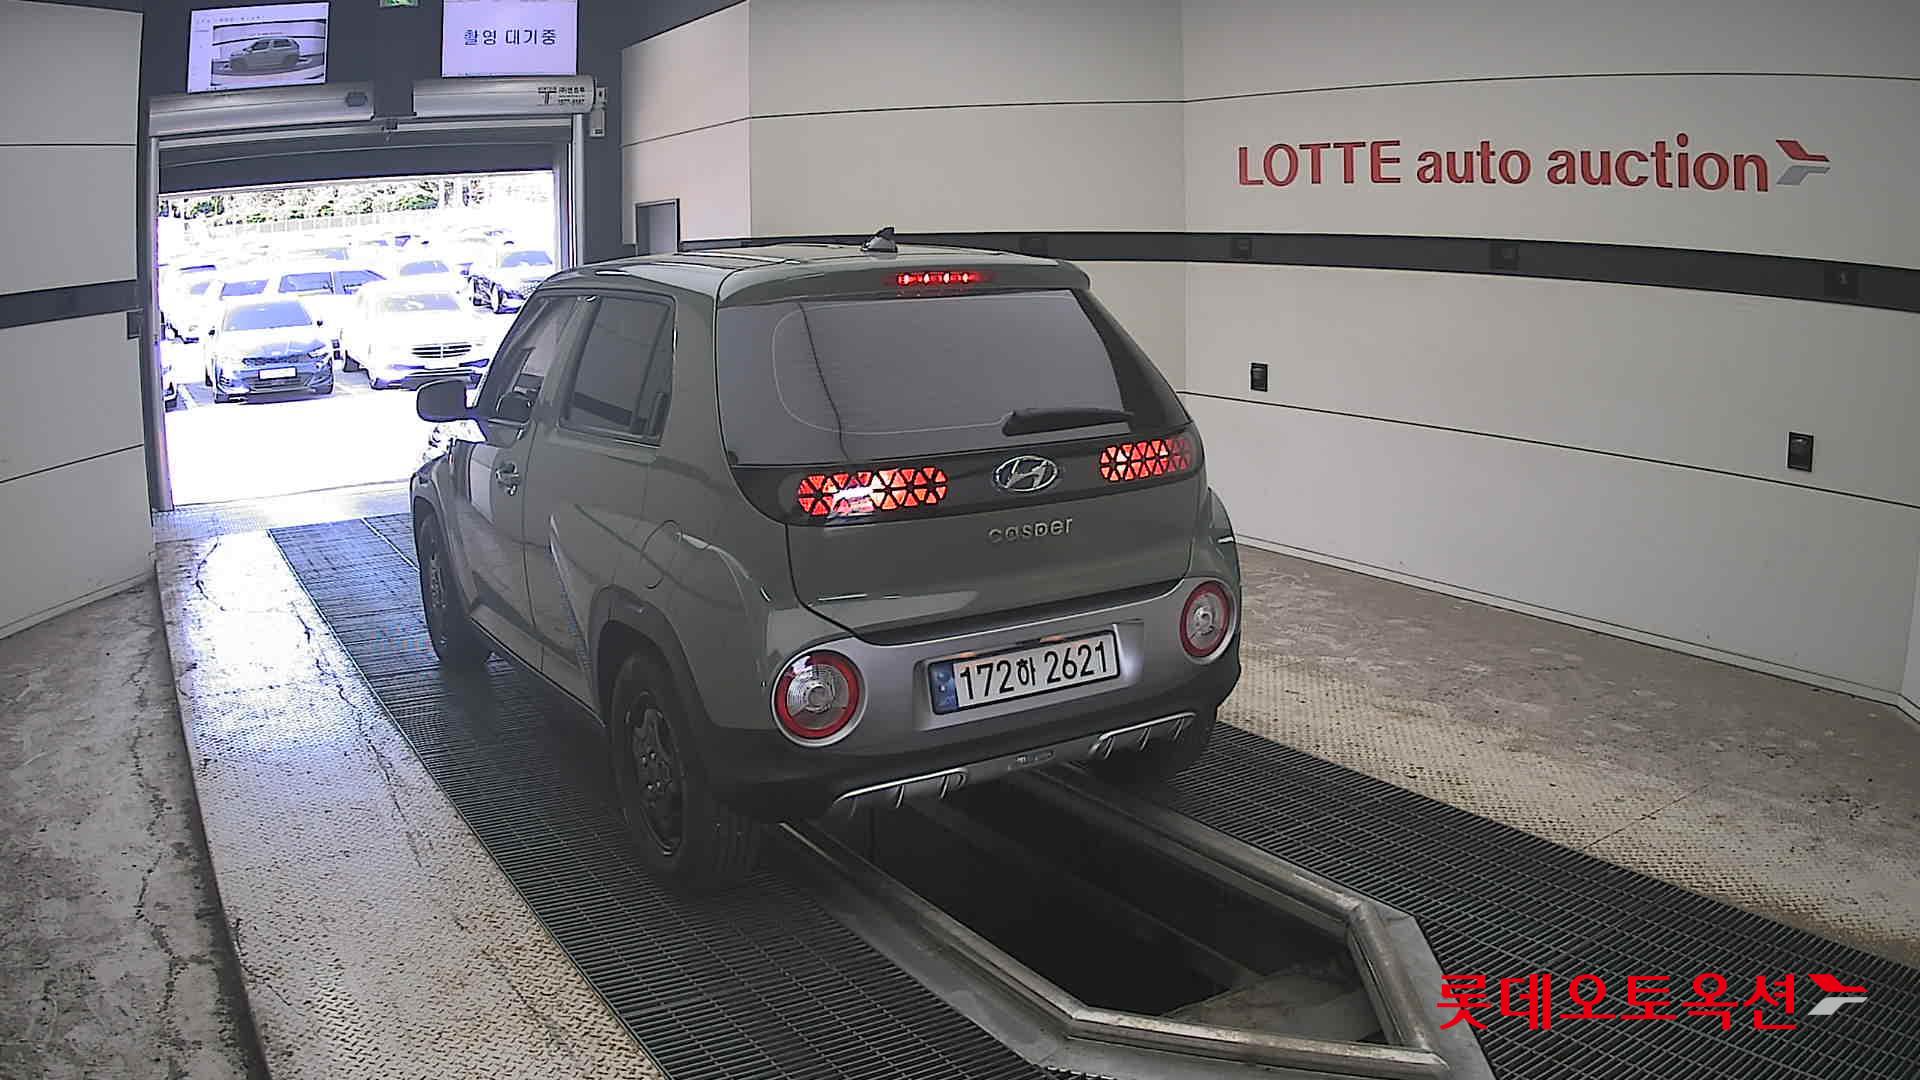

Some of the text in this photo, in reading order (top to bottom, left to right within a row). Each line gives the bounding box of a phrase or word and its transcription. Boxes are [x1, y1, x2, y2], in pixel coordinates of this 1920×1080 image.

[505, 29, 556, 46] 대기중
[1238, 134, 1769, 192] LOTTE auto auction
[959, 640, 1107, 700] 172하 2621
